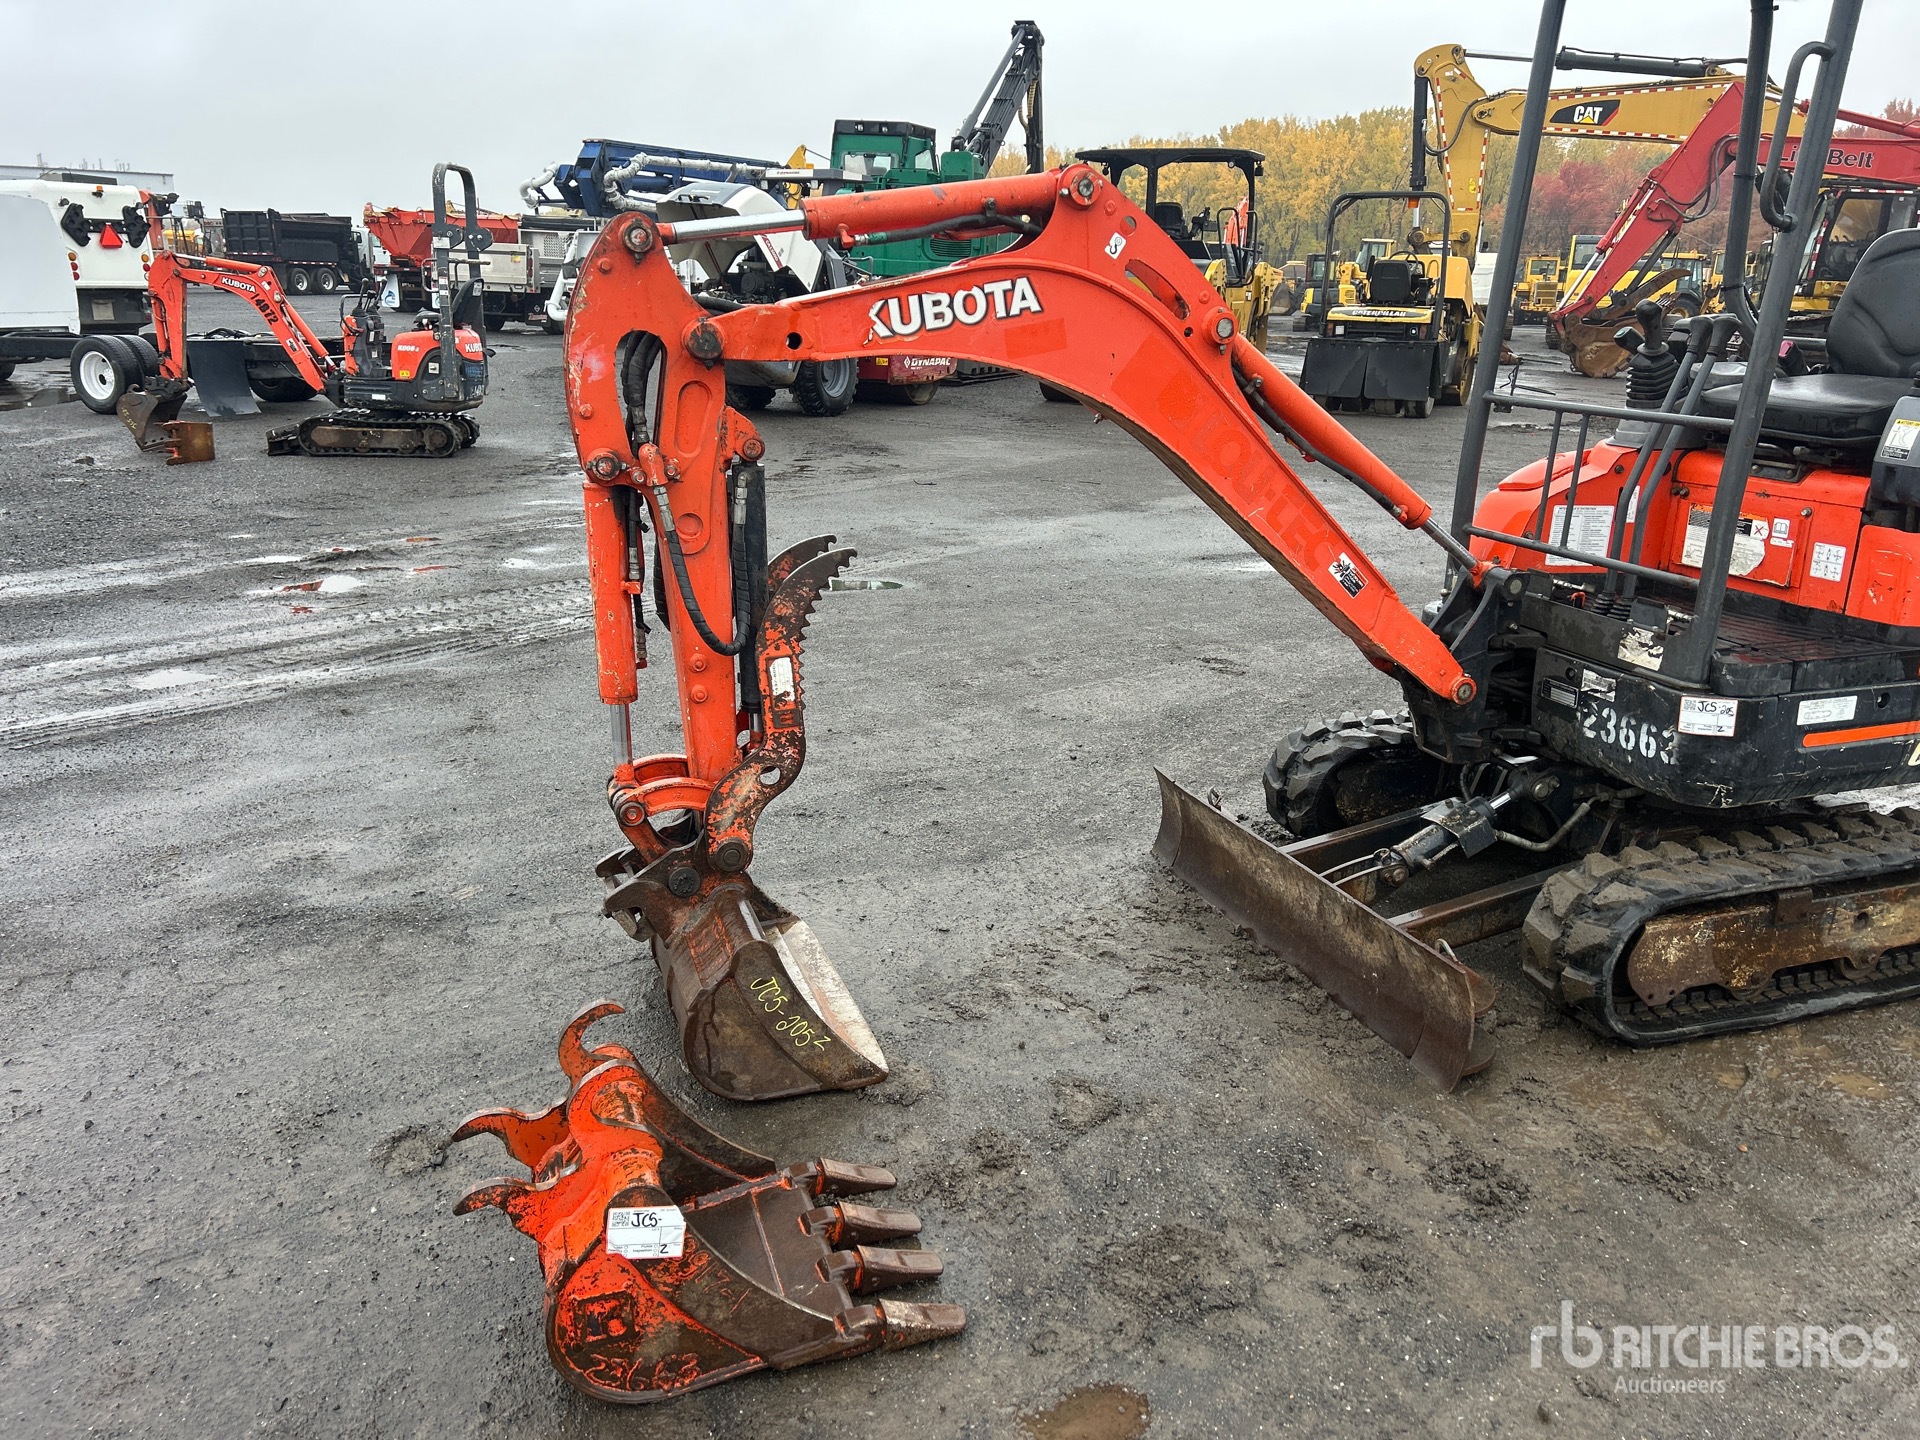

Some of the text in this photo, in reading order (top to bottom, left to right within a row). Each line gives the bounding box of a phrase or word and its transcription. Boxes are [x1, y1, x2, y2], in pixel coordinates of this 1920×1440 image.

[1573, 105, 1603, 124] CAT
[221, 276, 256, 293] KUBOTA
[868, 276, 1042, 338] KUBOTA
[910, 358, 951, 367] DYNAPAC
